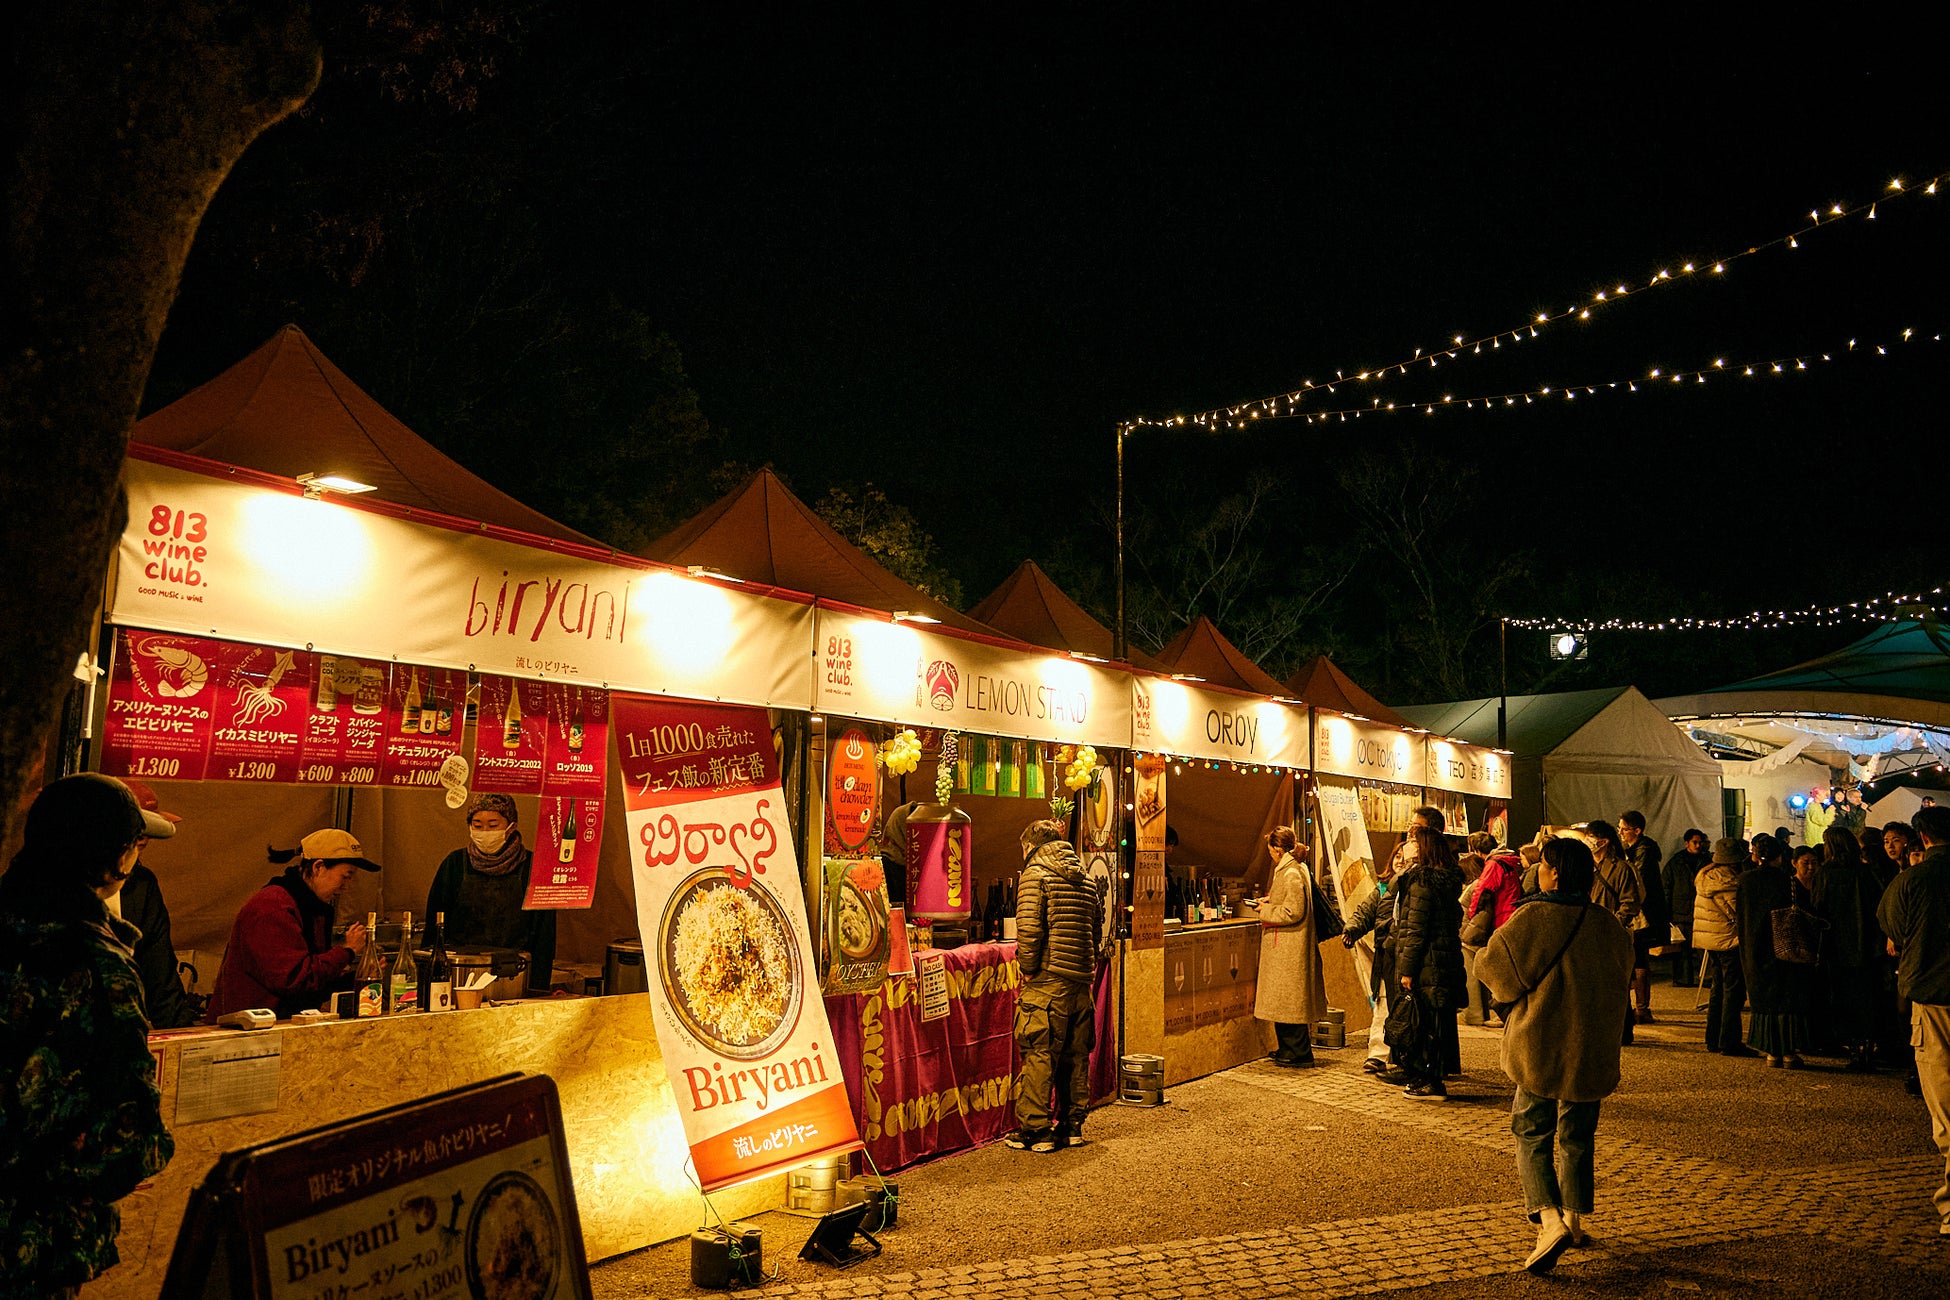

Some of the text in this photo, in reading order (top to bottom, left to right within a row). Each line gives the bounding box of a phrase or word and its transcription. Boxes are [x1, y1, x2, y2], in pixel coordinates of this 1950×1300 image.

[148, 504, 208, 543] 813
[143, 537, 208, 563] wine
[144, 558, 208, 587] club.
[465, 570, 631, 643] biryani
[828, 636, 851, 658] 813
[515, 656, 579, 675] 流しのビリヤニ
[826, 655, 852, 670] wine
[828, 670, 853, 686] club.
[967, 674, 1031, 717] LEMON
[1037, 685, 1087, 724] STAND
[1137, 694, 1150, 710] 813
[113, 700, 209, 719] アメリケーヌソースの
[123, 717, 194, 733] エビビリヤニ
[309, 714, 340, 726] クラフト
[348, 718, 383, 727] スパイシー
[215, 728, 298, 744] イカスミビリヤニ
[311, 726, 336, 736] コーラ
[346, 728, 382, 738] ジンジャー
[626, 722, 755, 758] 1日1000食売れた
[351, 738, 376, 749] ソーダ
[388, 744, 456, 760] ナチュラルワイン
[299, 765, 334, 781] ¥600
[341, 766, 375, 783] ¥800
[556, 763, 594, 773] ロッソ2019
[636, 751, 765, 797] フェス飯の新定番
[1448, 760, 1465, 779] TEO
[911, 829, 920, 906] レモンサワー
[682, 1042, 828, 1112] Biryani
[733, 1123, 818, 1159] 流しのビリヤニ
[283, 1208, 399, 1284] Biryani
